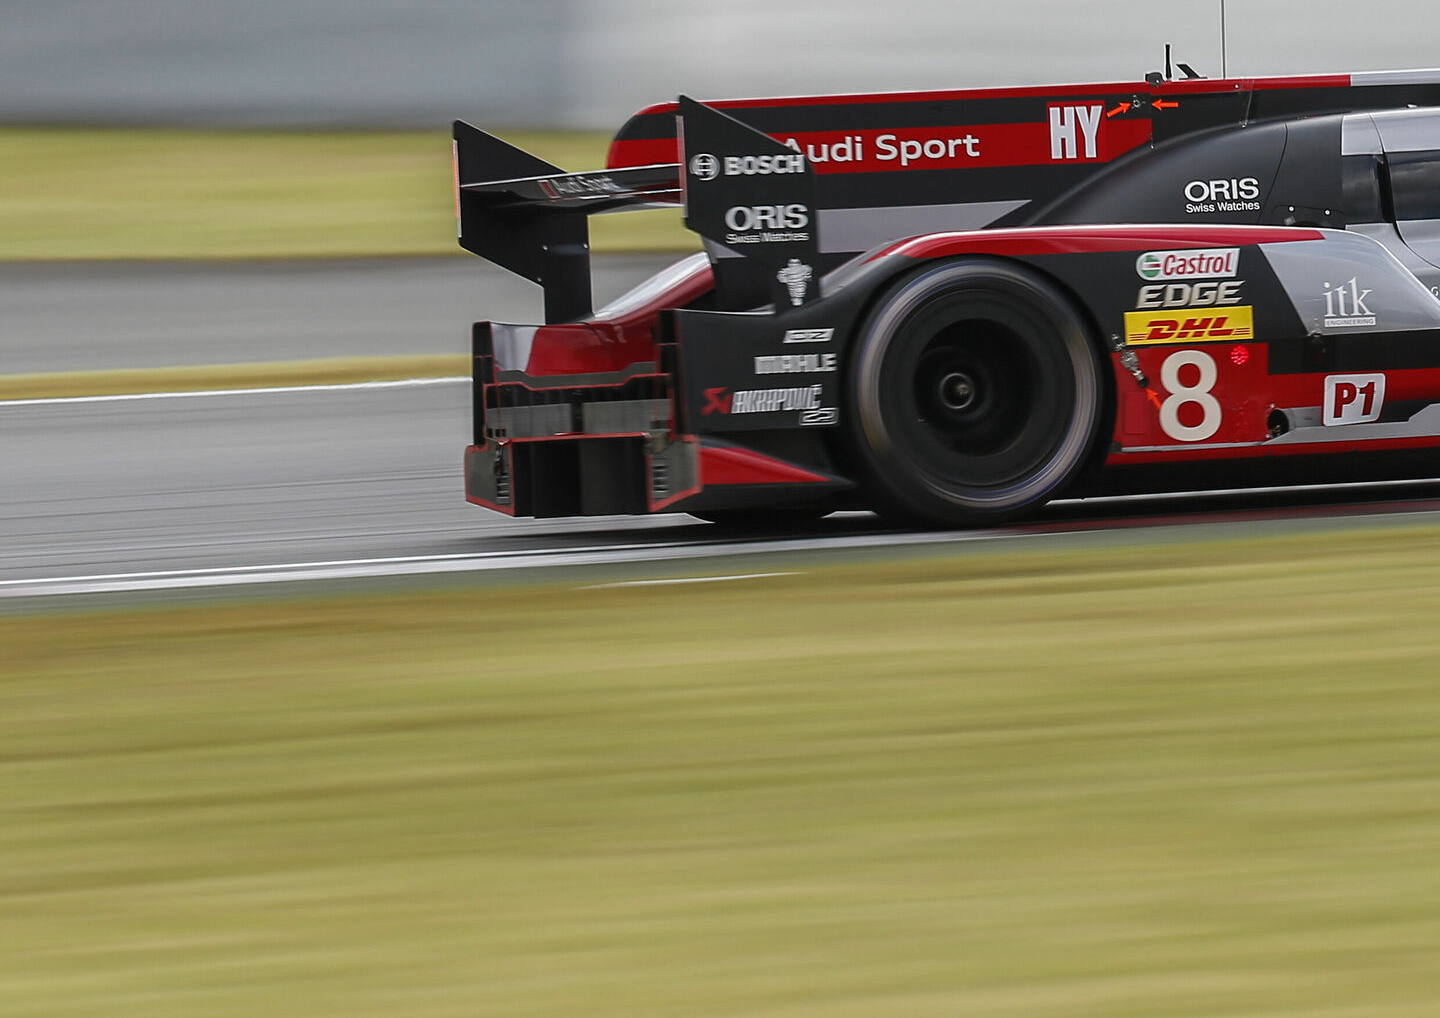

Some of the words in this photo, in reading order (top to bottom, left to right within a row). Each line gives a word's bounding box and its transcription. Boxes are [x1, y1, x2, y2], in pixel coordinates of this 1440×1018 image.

[1050, 105, 1102, 159] HY
[875, 134, 980, 165] Sport
[724, 154, 805, 176] BOSCH
[1184, 178, 1259, 202] ORIS
[725, 204, 809, 231] ORIS
[1185, 203, 1215, 213] Swiss
[1217, 201, 1260, 211] Watches
[1163, 252, 1233, 276] Castrol
[1137, 281, 1245, 308] EDGE
[1322, 277, 1376, 317] itk
[1147, 316, 1234, 339] DHL
[1160, 350, 1222, 441] 8
[1333, 382, 1375, 419] P1
